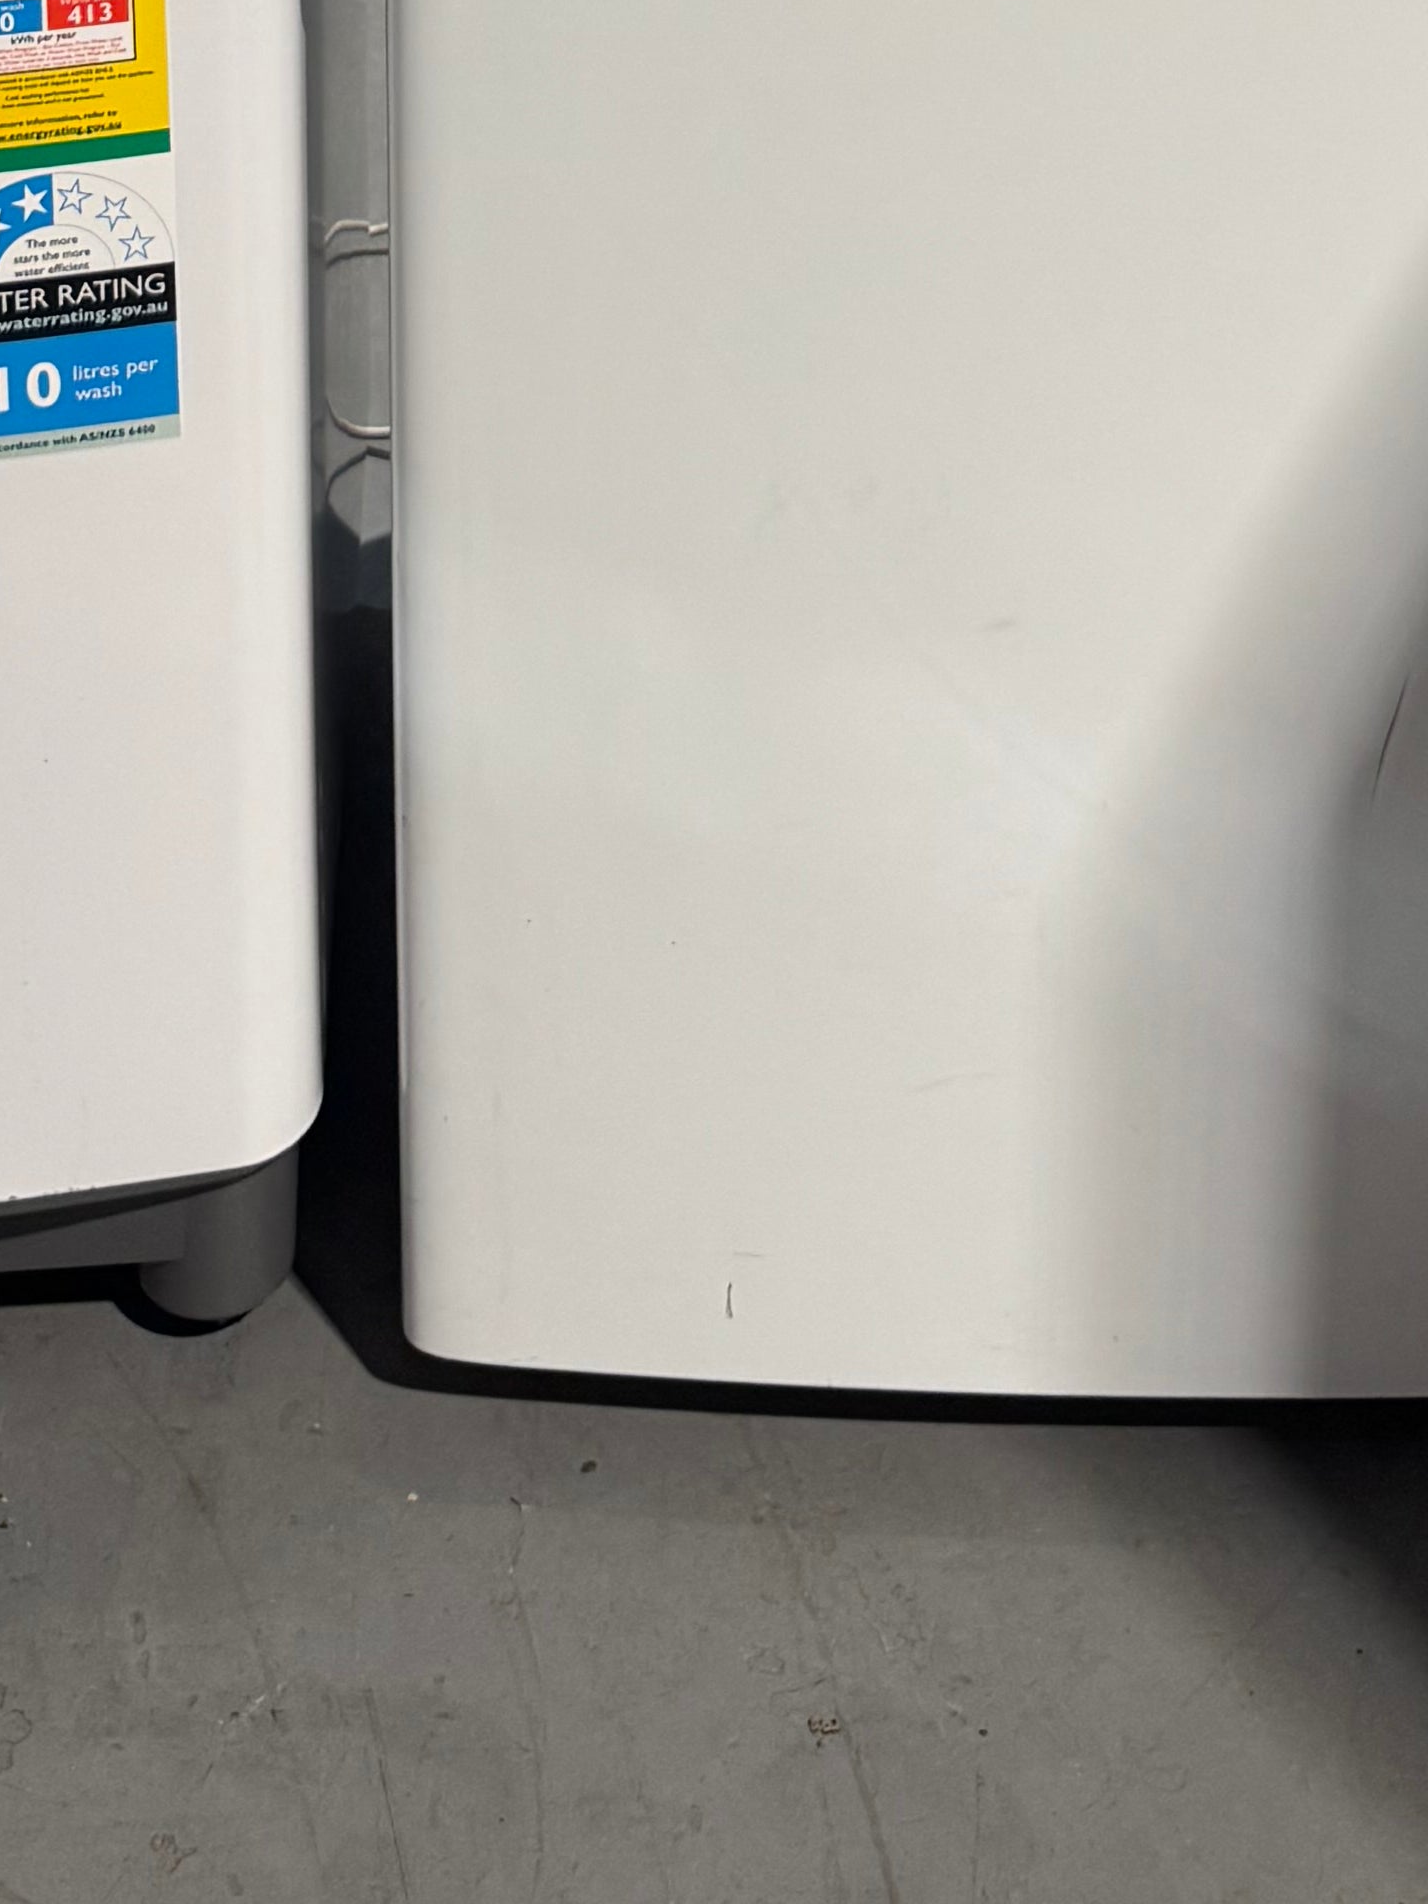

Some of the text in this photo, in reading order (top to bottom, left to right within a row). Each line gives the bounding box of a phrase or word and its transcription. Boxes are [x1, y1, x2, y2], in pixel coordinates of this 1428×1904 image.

[0, 2, 25, 12] wash
[67, 2, 114, 25] 413
[10, 31, 77, 45] kWh per year
[25, 237, 79, 249] The more
[13, 248, 91, 264] stars the more
[14, 261, 90, 277] water efficient
[57, 272, 167, 306] RATING
[72, 358, 159, 382] litres per
[74, 381, 123, 402] wash
[52, 434, 77, 446] with
